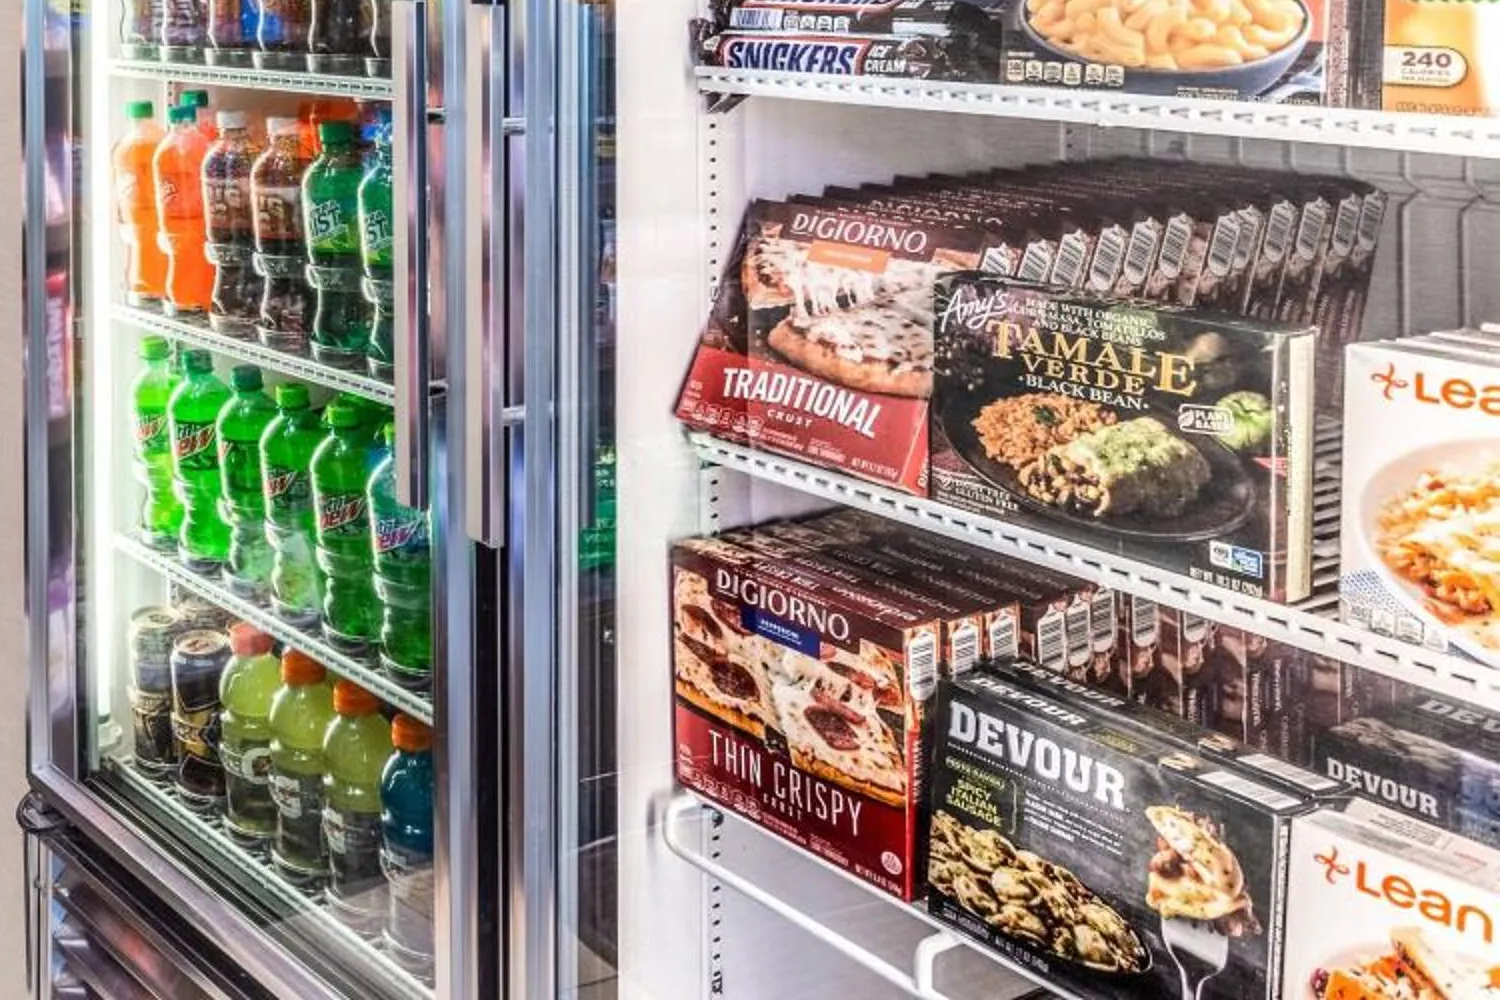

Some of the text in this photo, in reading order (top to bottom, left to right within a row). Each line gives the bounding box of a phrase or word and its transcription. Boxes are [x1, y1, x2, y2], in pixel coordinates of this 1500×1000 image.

[728, 41, 858, 76] SNICKERS
[864, 60, 907, 74] CREAM
[1401, 51, 1452, 68] 240
[790, 212, 928, 255] DIGIORNO
[939, 288, 1010, 333] Amy's
[1061, 303, 1094, 319] WITH
[985, 318, 1198, 398] TAMALE
[1020, 352, 1146, 397] VERDE
[722, 366, 884, 440] TRADITIONAL
[1026, 373, 1144, 411] BLACK BEAN
[1414, 371, 1500, 417] Lea
[767, 407, 814, 429] CRUST
[715, 568, 850, 642] DIGIORNO
[948, 699, 1129, 811] DEVOUR
[708, 727, 863, 837] THIN CRISPY
[1326, 756, 1440, 818] DEVOUR
[1355, 861, 1494, 944] Lean
